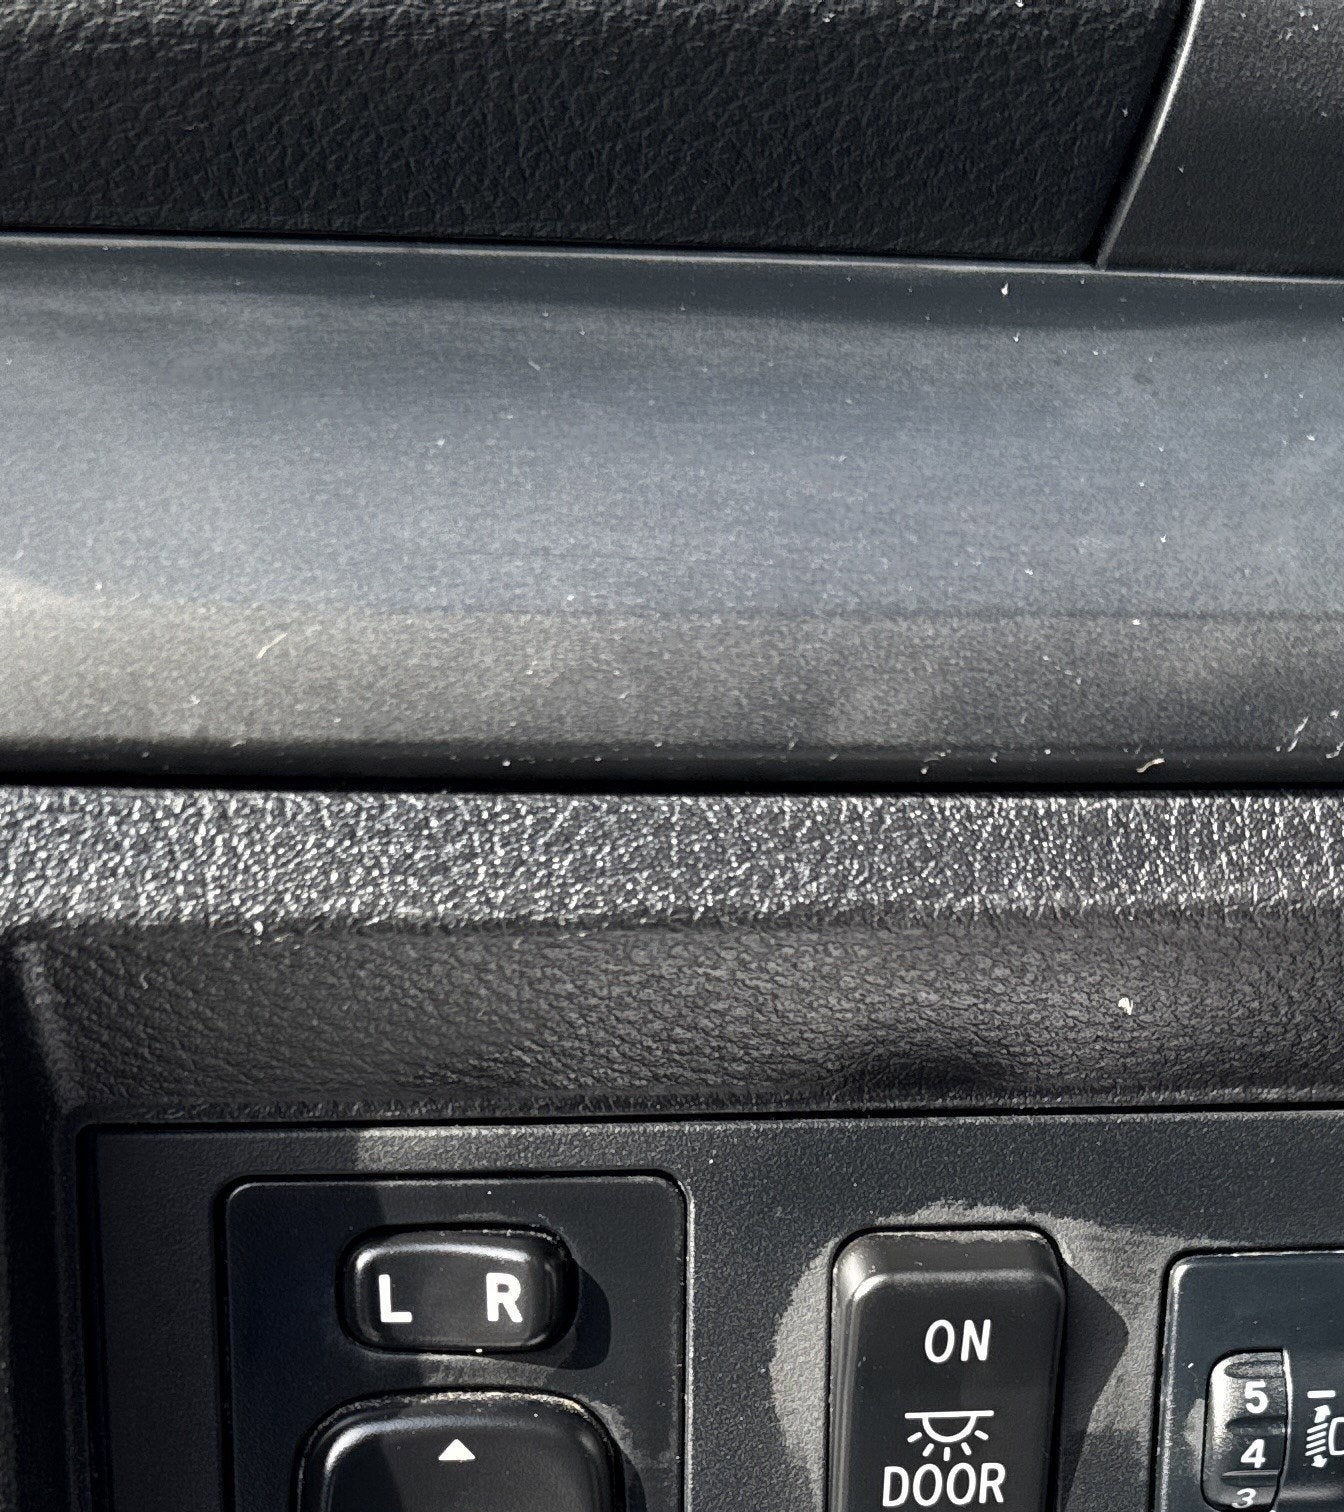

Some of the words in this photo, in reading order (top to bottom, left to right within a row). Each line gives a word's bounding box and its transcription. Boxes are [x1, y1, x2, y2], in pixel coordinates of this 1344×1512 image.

[379, 1274, 412, 1323] L
[486, 1272, 523, 1324] R
[925, 1319, 991, 1363] ON
[1244, 1379, 1269, 1413] 5
[1241, 1438, 1266, 1469] 4
[883, 1463, 1005, 1506] DOOR
